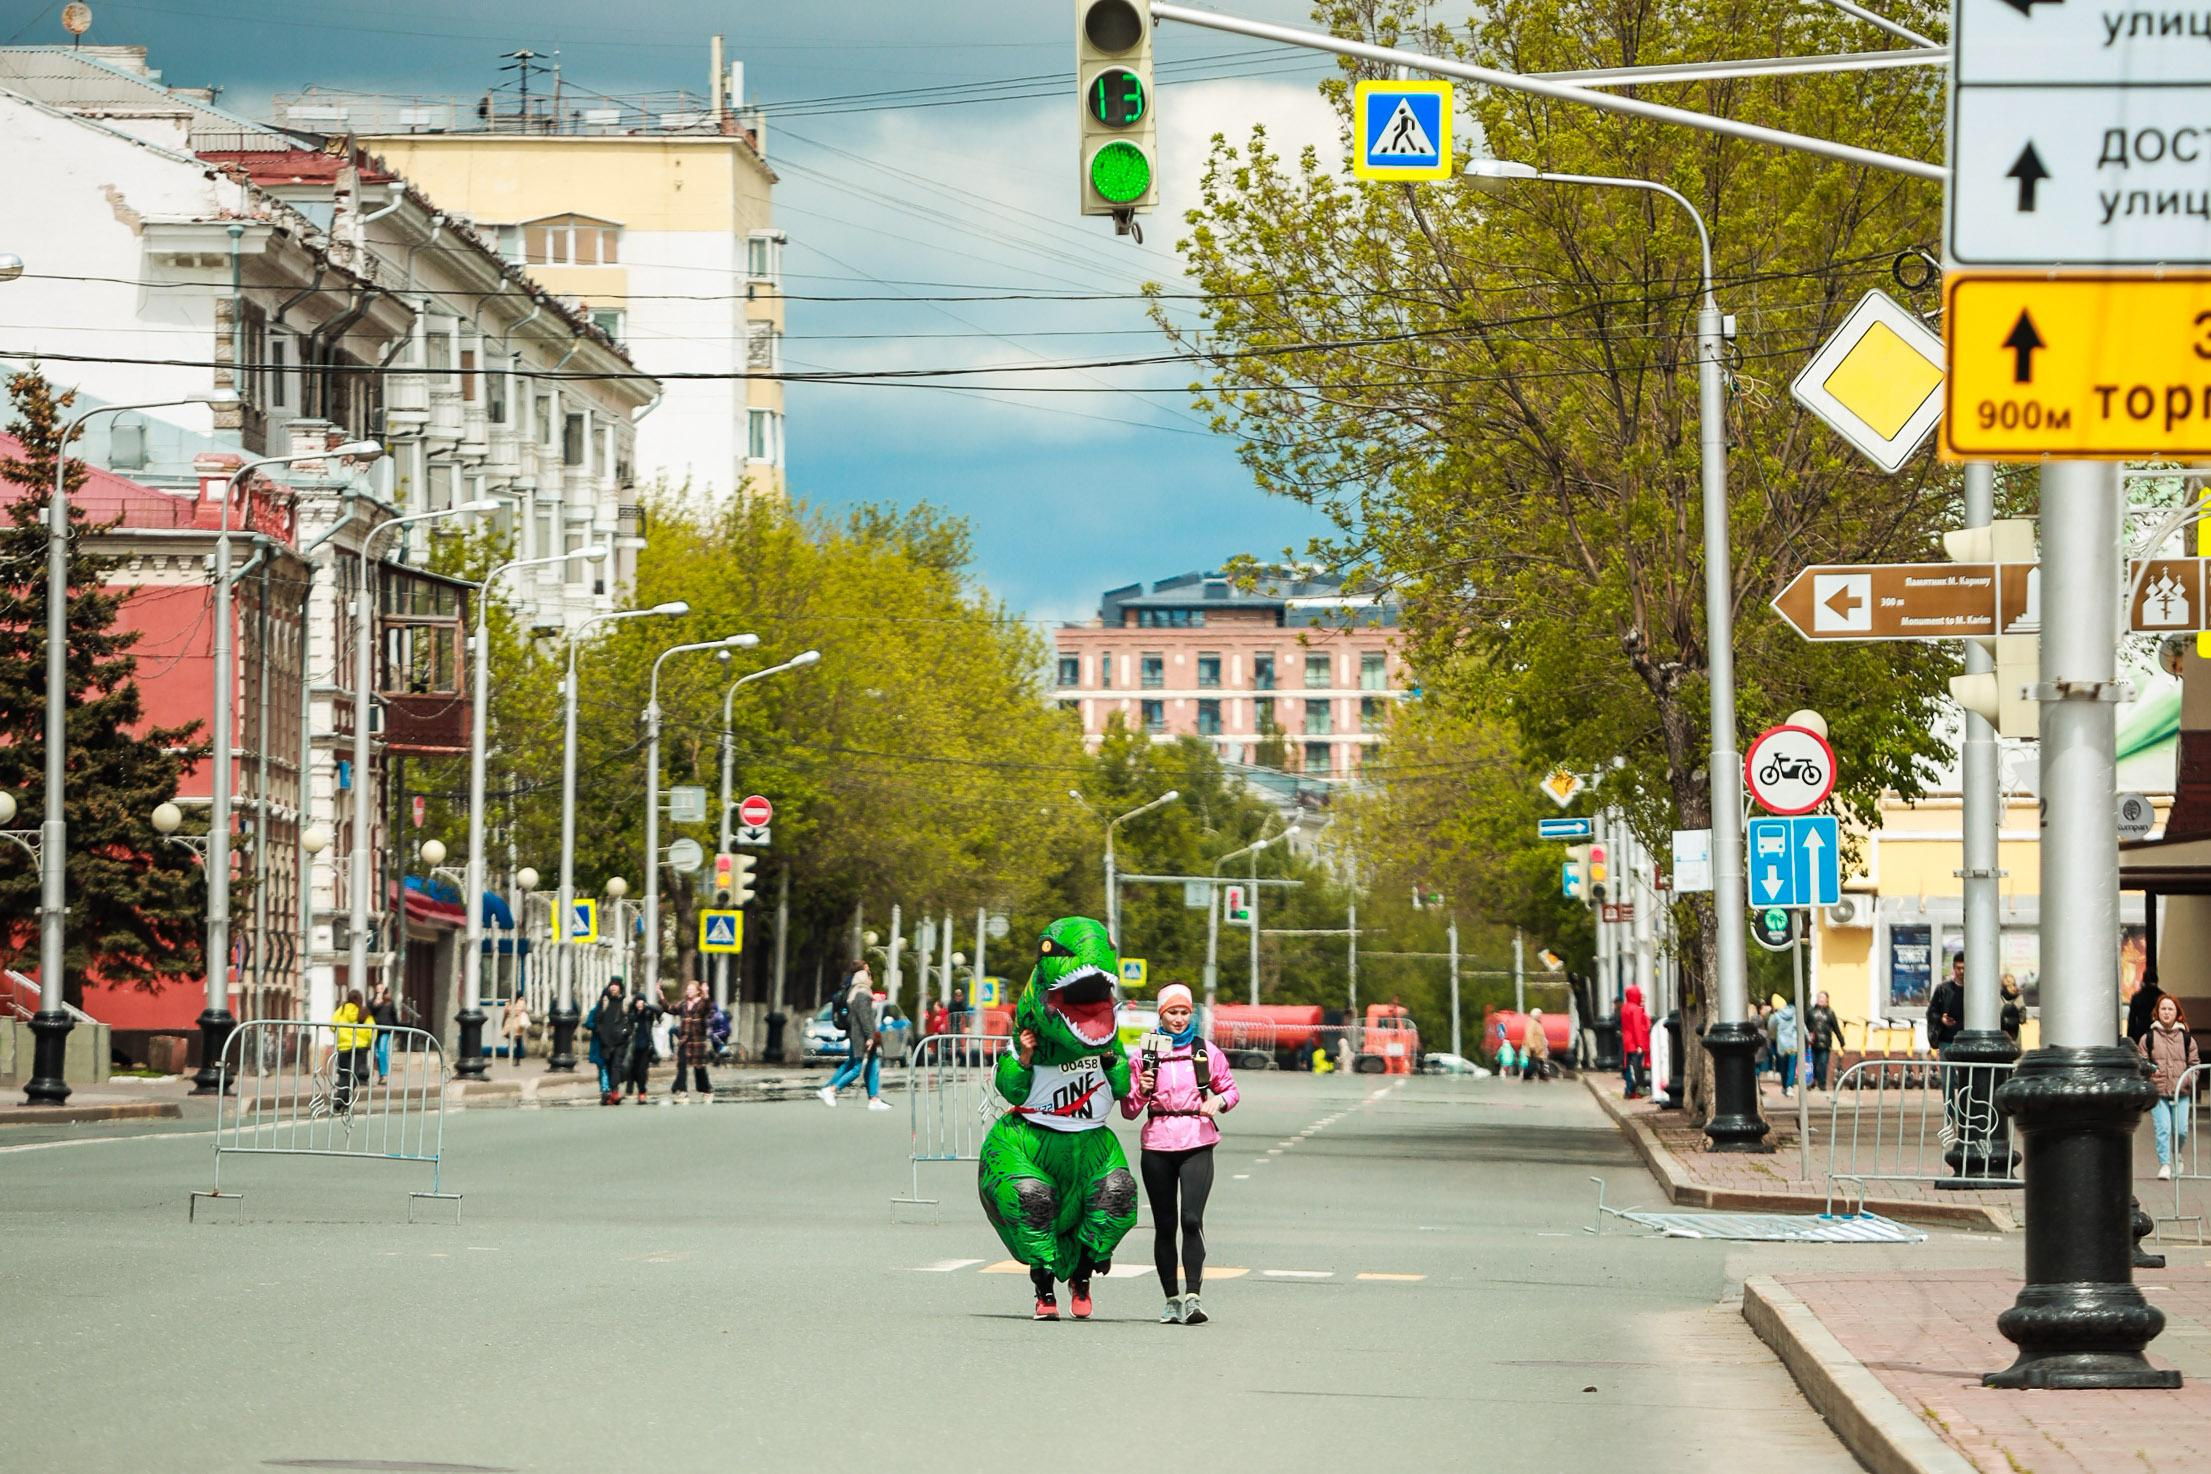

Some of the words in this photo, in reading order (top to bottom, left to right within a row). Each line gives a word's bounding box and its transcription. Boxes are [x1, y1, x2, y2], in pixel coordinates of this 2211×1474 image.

[2102, 11, 2211, 49] улиц
[1098, 73, 1143, 122] 13
[2097, 128, 2211, 170] ДОС
[2099, 190, 2209, 225] улиц
[1978, 399, 2071, 430] 900м
[1901, 616, 1944, 626] Monument
[1945, 616, 1954, 625] to
[1061, 1058, 1098, 1073] 00458
